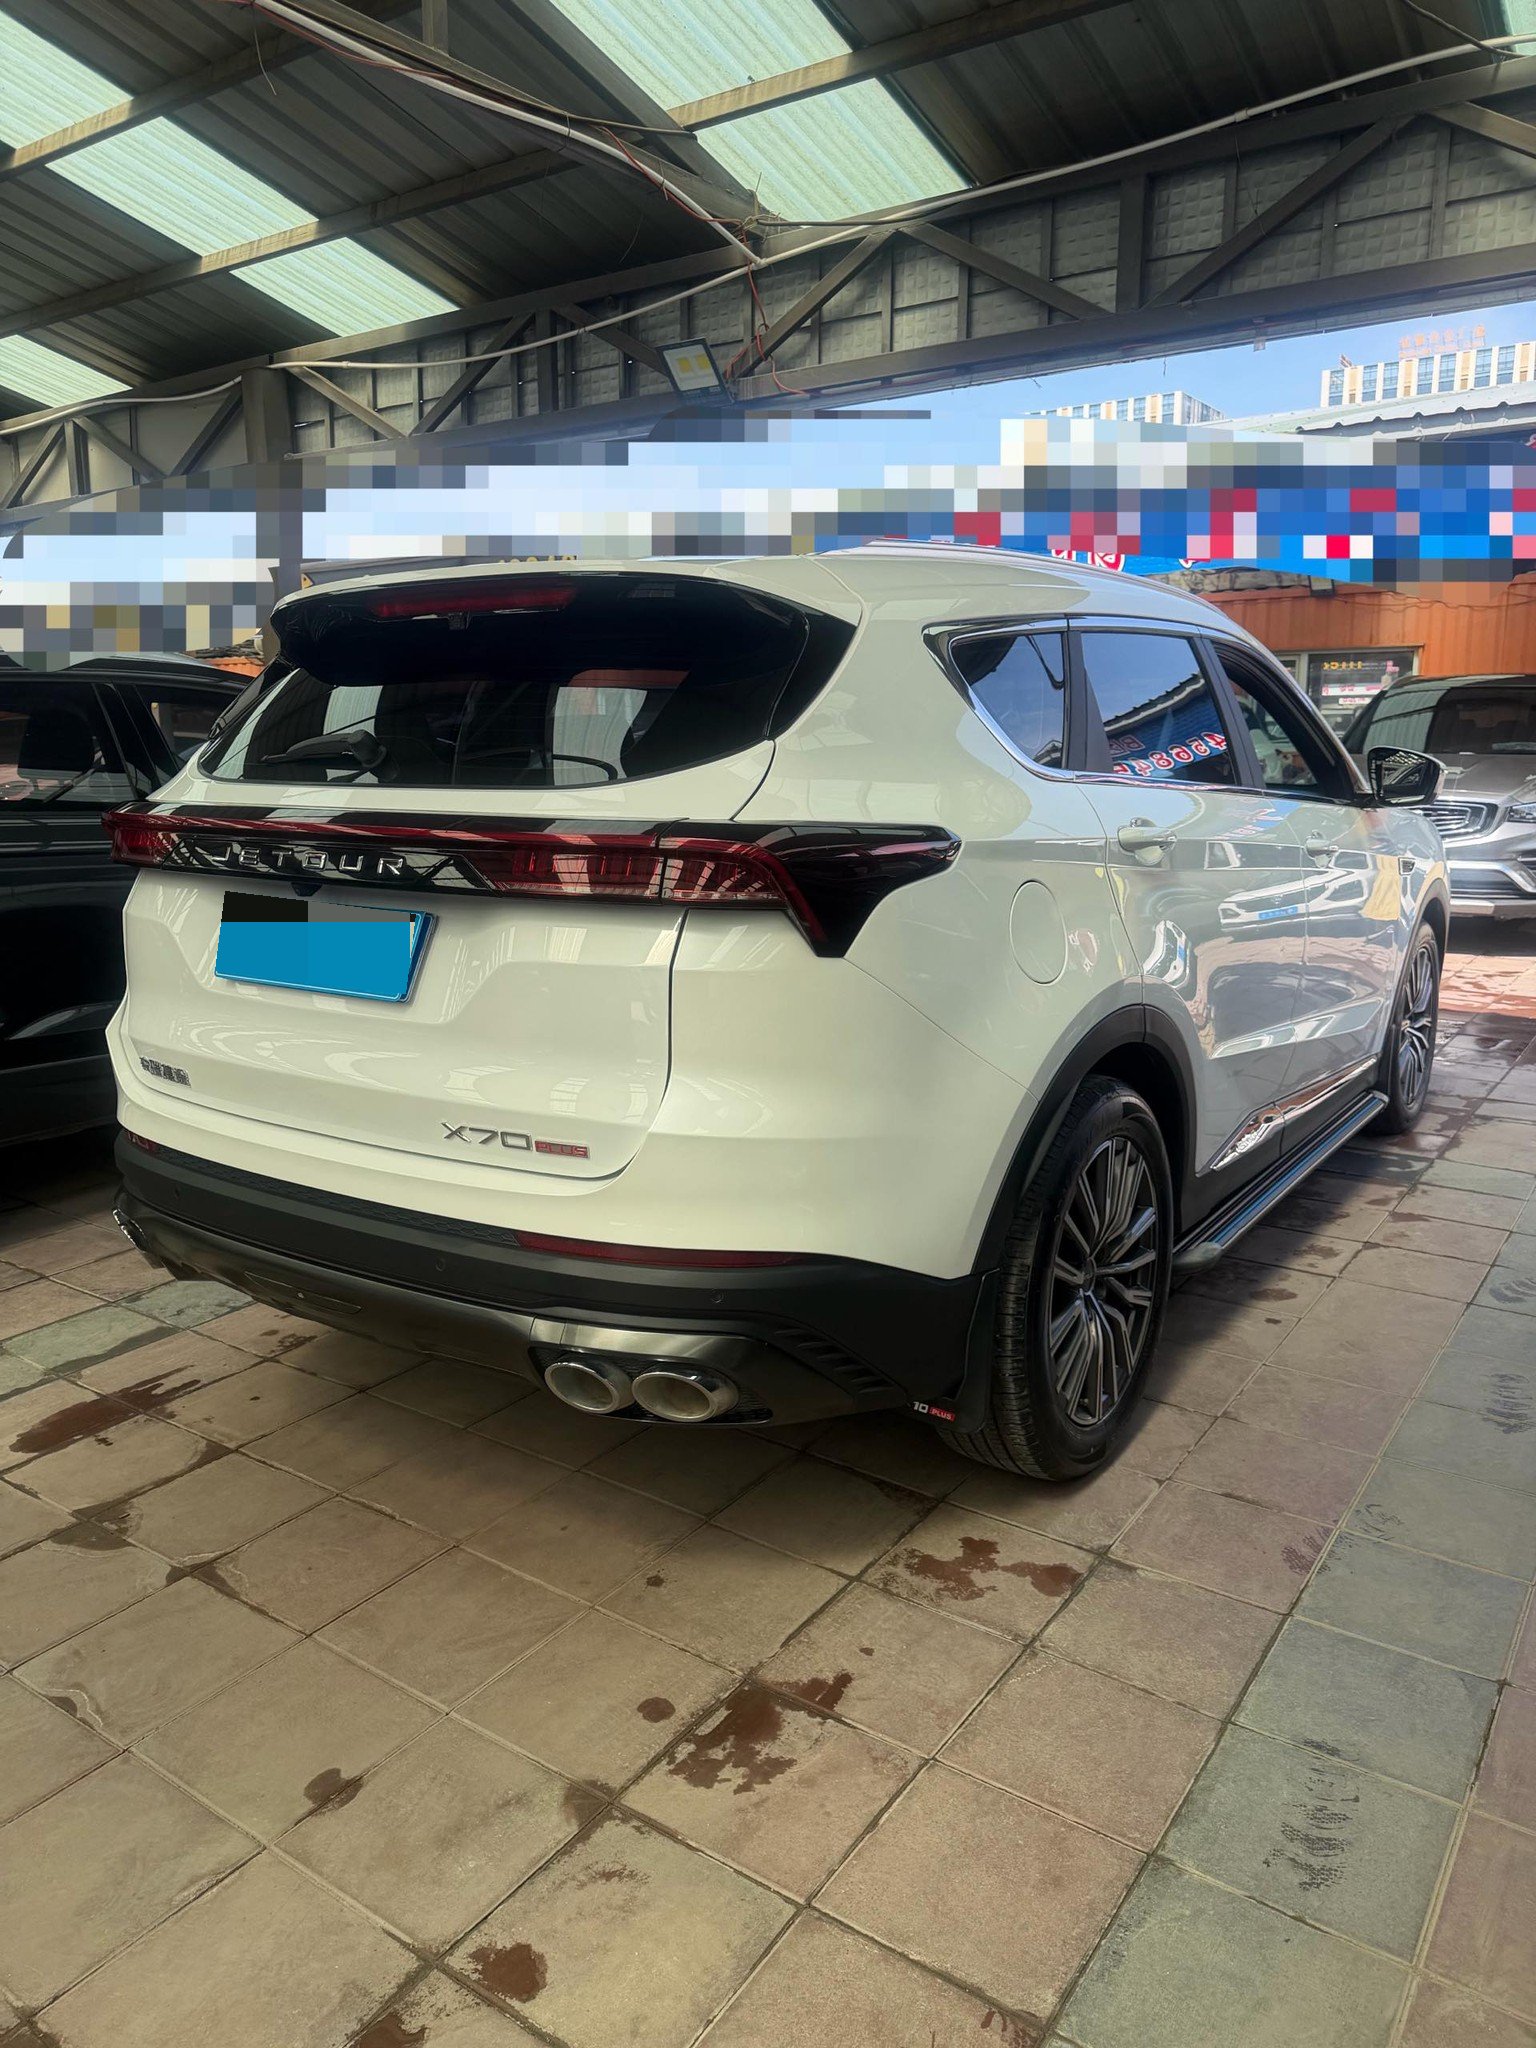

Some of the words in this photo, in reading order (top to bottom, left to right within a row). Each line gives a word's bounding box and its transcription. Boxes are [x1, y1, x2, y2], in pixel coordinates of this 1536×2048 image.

[211, 846, 404, 876] JETOUR
[439, 1122, 533, 1151] X70
[534, 1140, 590, 1159] PLUS
[930, 1407, 955, 1421] PLUS
